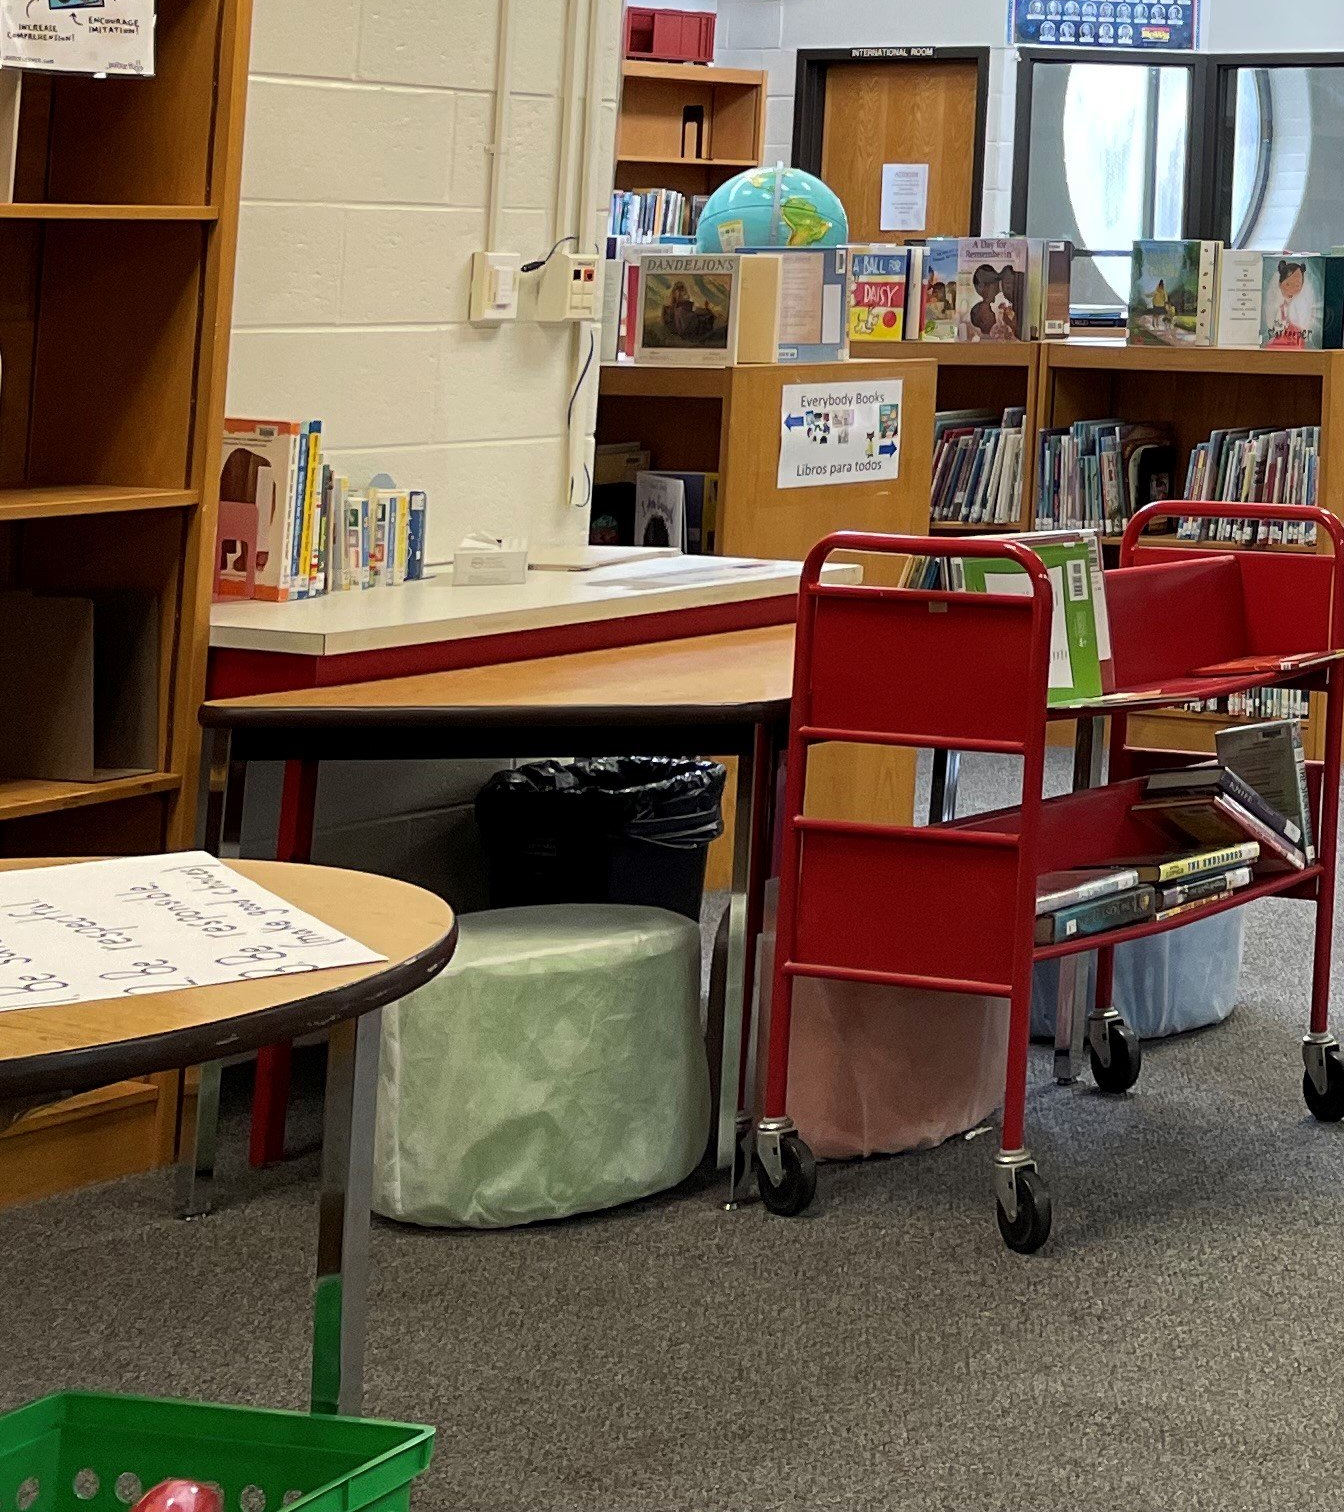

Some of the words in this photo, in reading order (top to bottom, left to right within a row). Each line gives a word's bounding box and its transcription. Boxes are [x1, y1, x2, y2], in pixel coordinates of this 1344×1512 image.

[88, 16, 140, 28] ENCOURAGE
[851, 48, 909, 58] INTERNATIONAL
[910, 47, 934, 57] ROOM
[972, 240, 978, 249] A
[980, 240, 995, 251] Day
[996, 239, 1008, 248] for
[647, 259, 735, 272] DANDELIONS
[853, 259, 860, 273] A
[863, 255, 887, 275] BALL
[863, 284, 900, 308] DAISY
[801, 392, 854, 408] Everybody
[855, 391, 885, 405] Books
[796, 463, 828, 477] Libros
[829, 463, 853, 477] para
[855, 460, 882, 472] todos
[214, 945, 287, 967] Be
[99, 958, 178, 981] Be
[0, 973, 69, 997] Be
